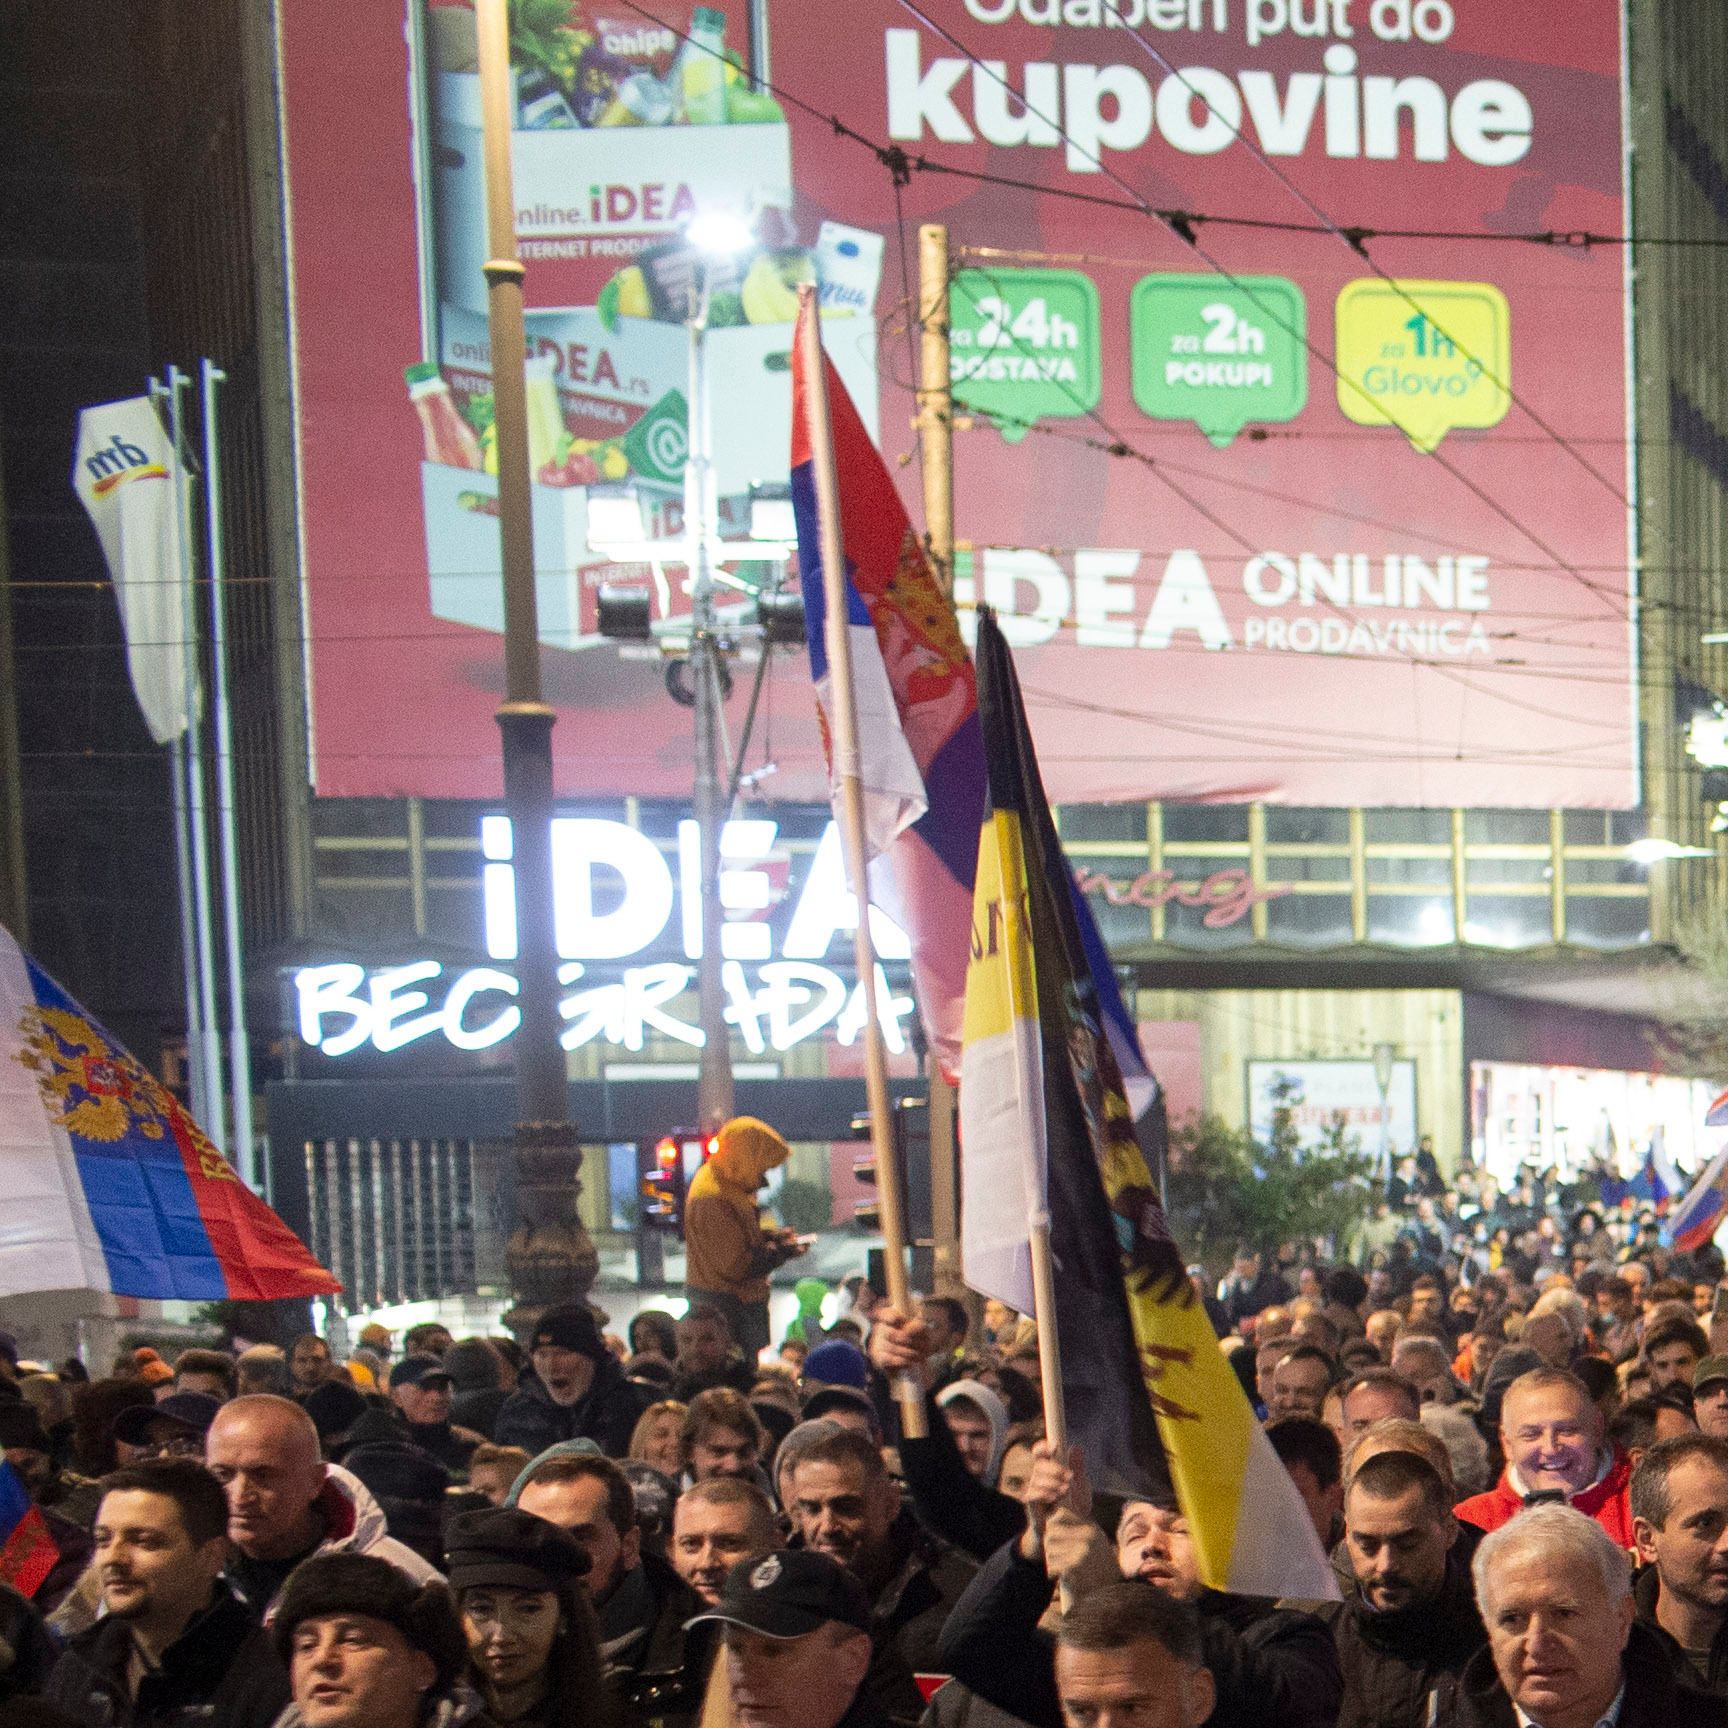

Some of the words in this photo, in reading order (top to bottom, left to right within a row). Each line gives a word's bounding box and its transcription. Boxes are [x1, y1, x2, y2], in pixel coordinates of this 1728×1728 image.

[1246, 0, 1355, 46] put
[884, 28, 1535, 173] kupovine
[976, 297, 1078, 348] 24h
[1201, 303, 1265, 354] 2h
[1405, 312, 1456, 358] 1h
[1165, 362, 1273, 386] POKUPI
[1362, 364, 1468, 396] Glovo
[1243, 551, 1490, 611] ONLINE
[1244, 616, 1490, 655] PRODAVNICA
